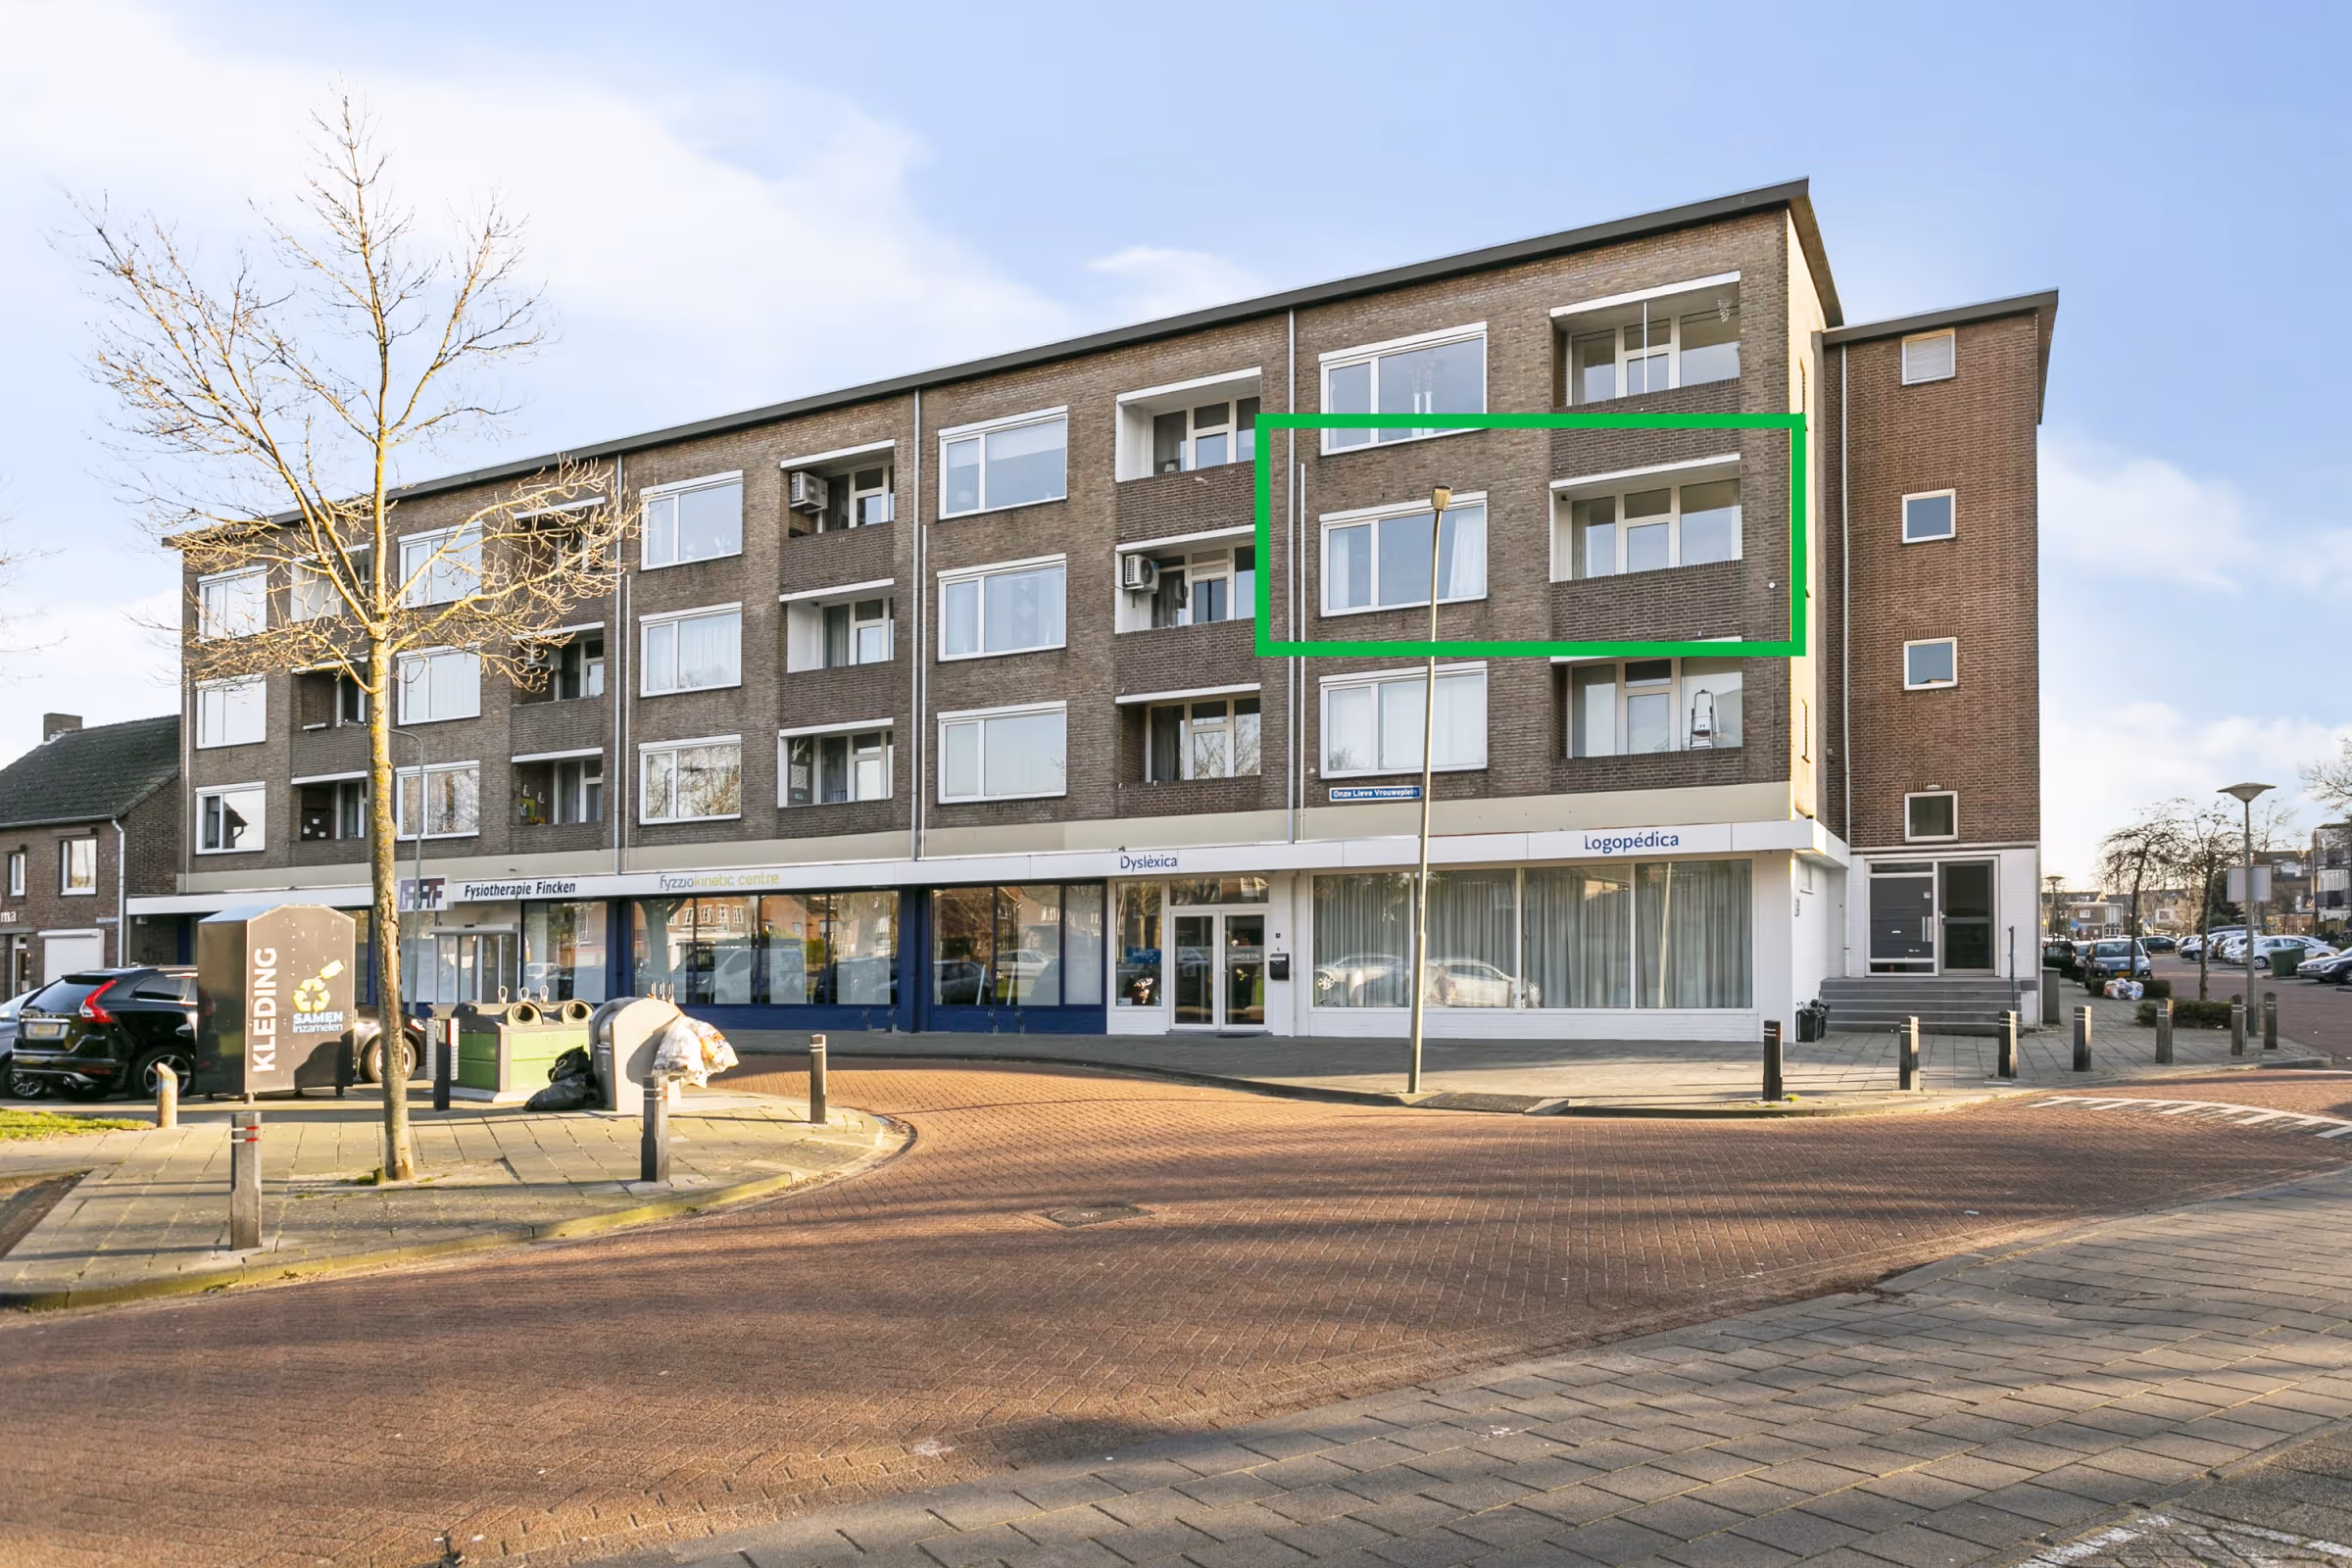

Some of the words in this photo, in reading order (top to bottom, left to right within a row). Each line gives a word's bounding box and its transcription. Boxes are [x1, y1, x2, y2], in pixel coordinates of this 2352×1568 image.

[1584, 831, 1679, 854] Logopédica
[738, 870, 780, 886] centre
[465, 884, 532, 901] Fysiotherapie
[536, 882, 576, 895] Fincken
[252, 948, 277, 1072] KLEDING
[293, 1011, 343, 1023] SAMEN
[293, 1022, 343, 1033] inzamelen
